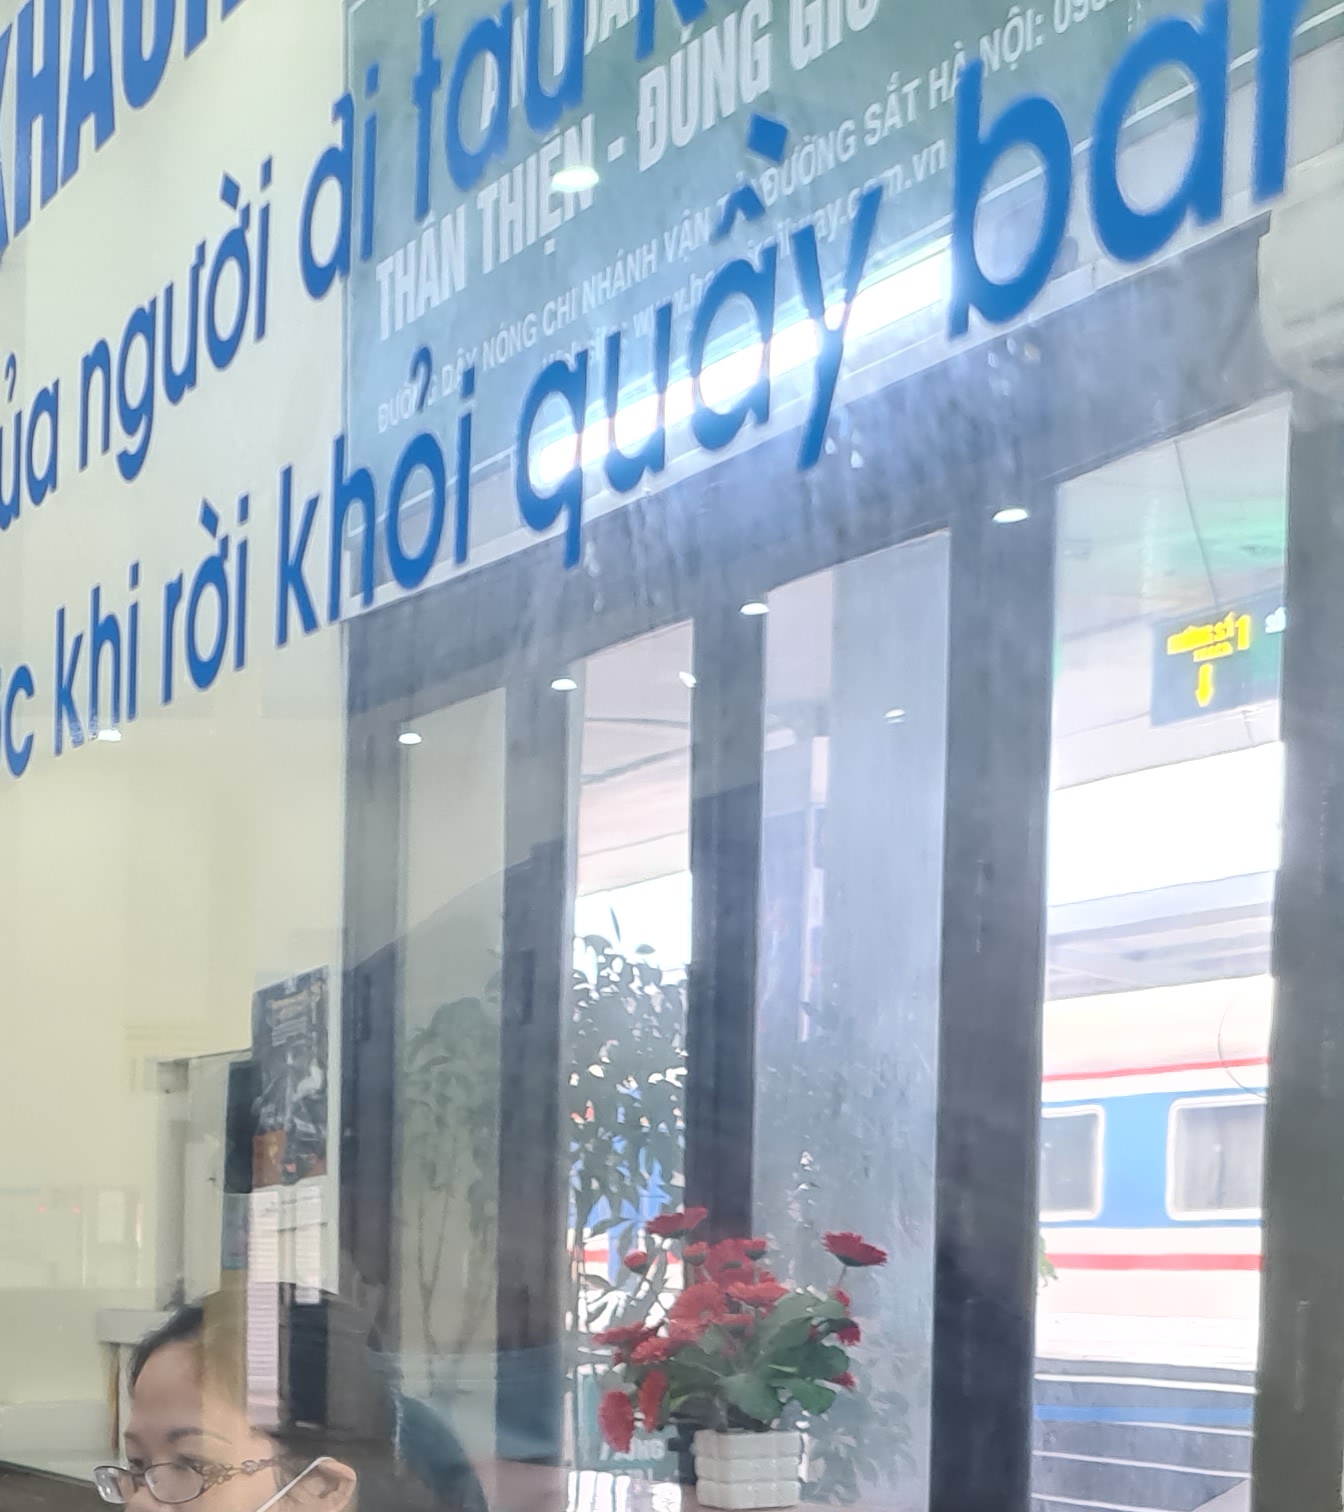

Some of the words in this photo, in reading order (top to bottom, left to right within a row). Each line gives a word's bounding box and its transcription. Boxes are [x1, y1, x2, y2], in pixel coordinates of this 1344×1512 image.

[78, 154, 274, 482] người
[299, 62, 380, 300] đi
[375, 205, 468, 342] THÂN
[477, 113, 596, 274] THIỆN
[636, 0, 773, 171] ĐÚNG
[481, 312, 539, 372] NÓNG
[541, 286, 578, 337] CHI
[581, 238, 658, 314] NHÁNH
[664, 207, 711, 263] VẬN
[763, 118, 857, 207] ĐƯỜNG
[864, 70, 923, 146] SẮT
[927, 40, 972, 109] HÀ
[979, 4, 1046, 78] NỘI:
[52, 560, 140, 758] khi
[160, 493, 250, 707] rời
[274, 345, 476, 649] khỏi
[515, 112, 885, 573] quầy
